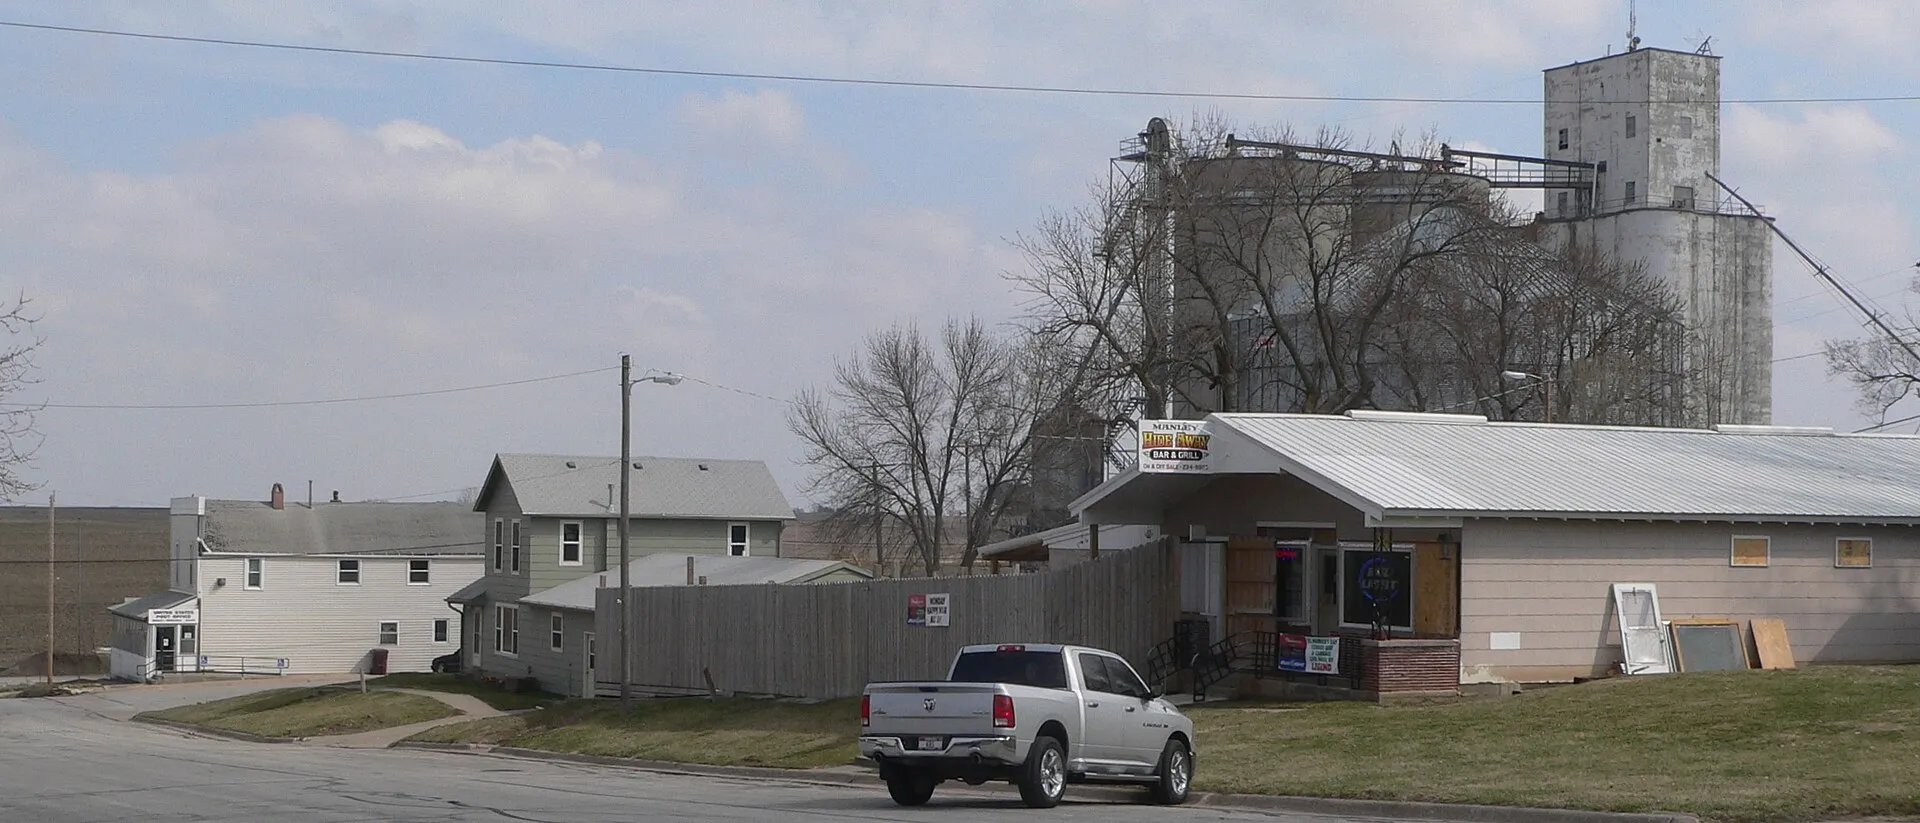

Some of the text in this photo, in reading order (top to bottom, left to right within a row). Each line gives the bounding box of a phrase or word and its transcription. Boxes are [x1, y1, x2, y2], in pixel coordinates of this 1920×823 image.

[1153, 423, 1196, 431] MANLEY
[1153, 451, 1200, 459] BAR & GRILL
